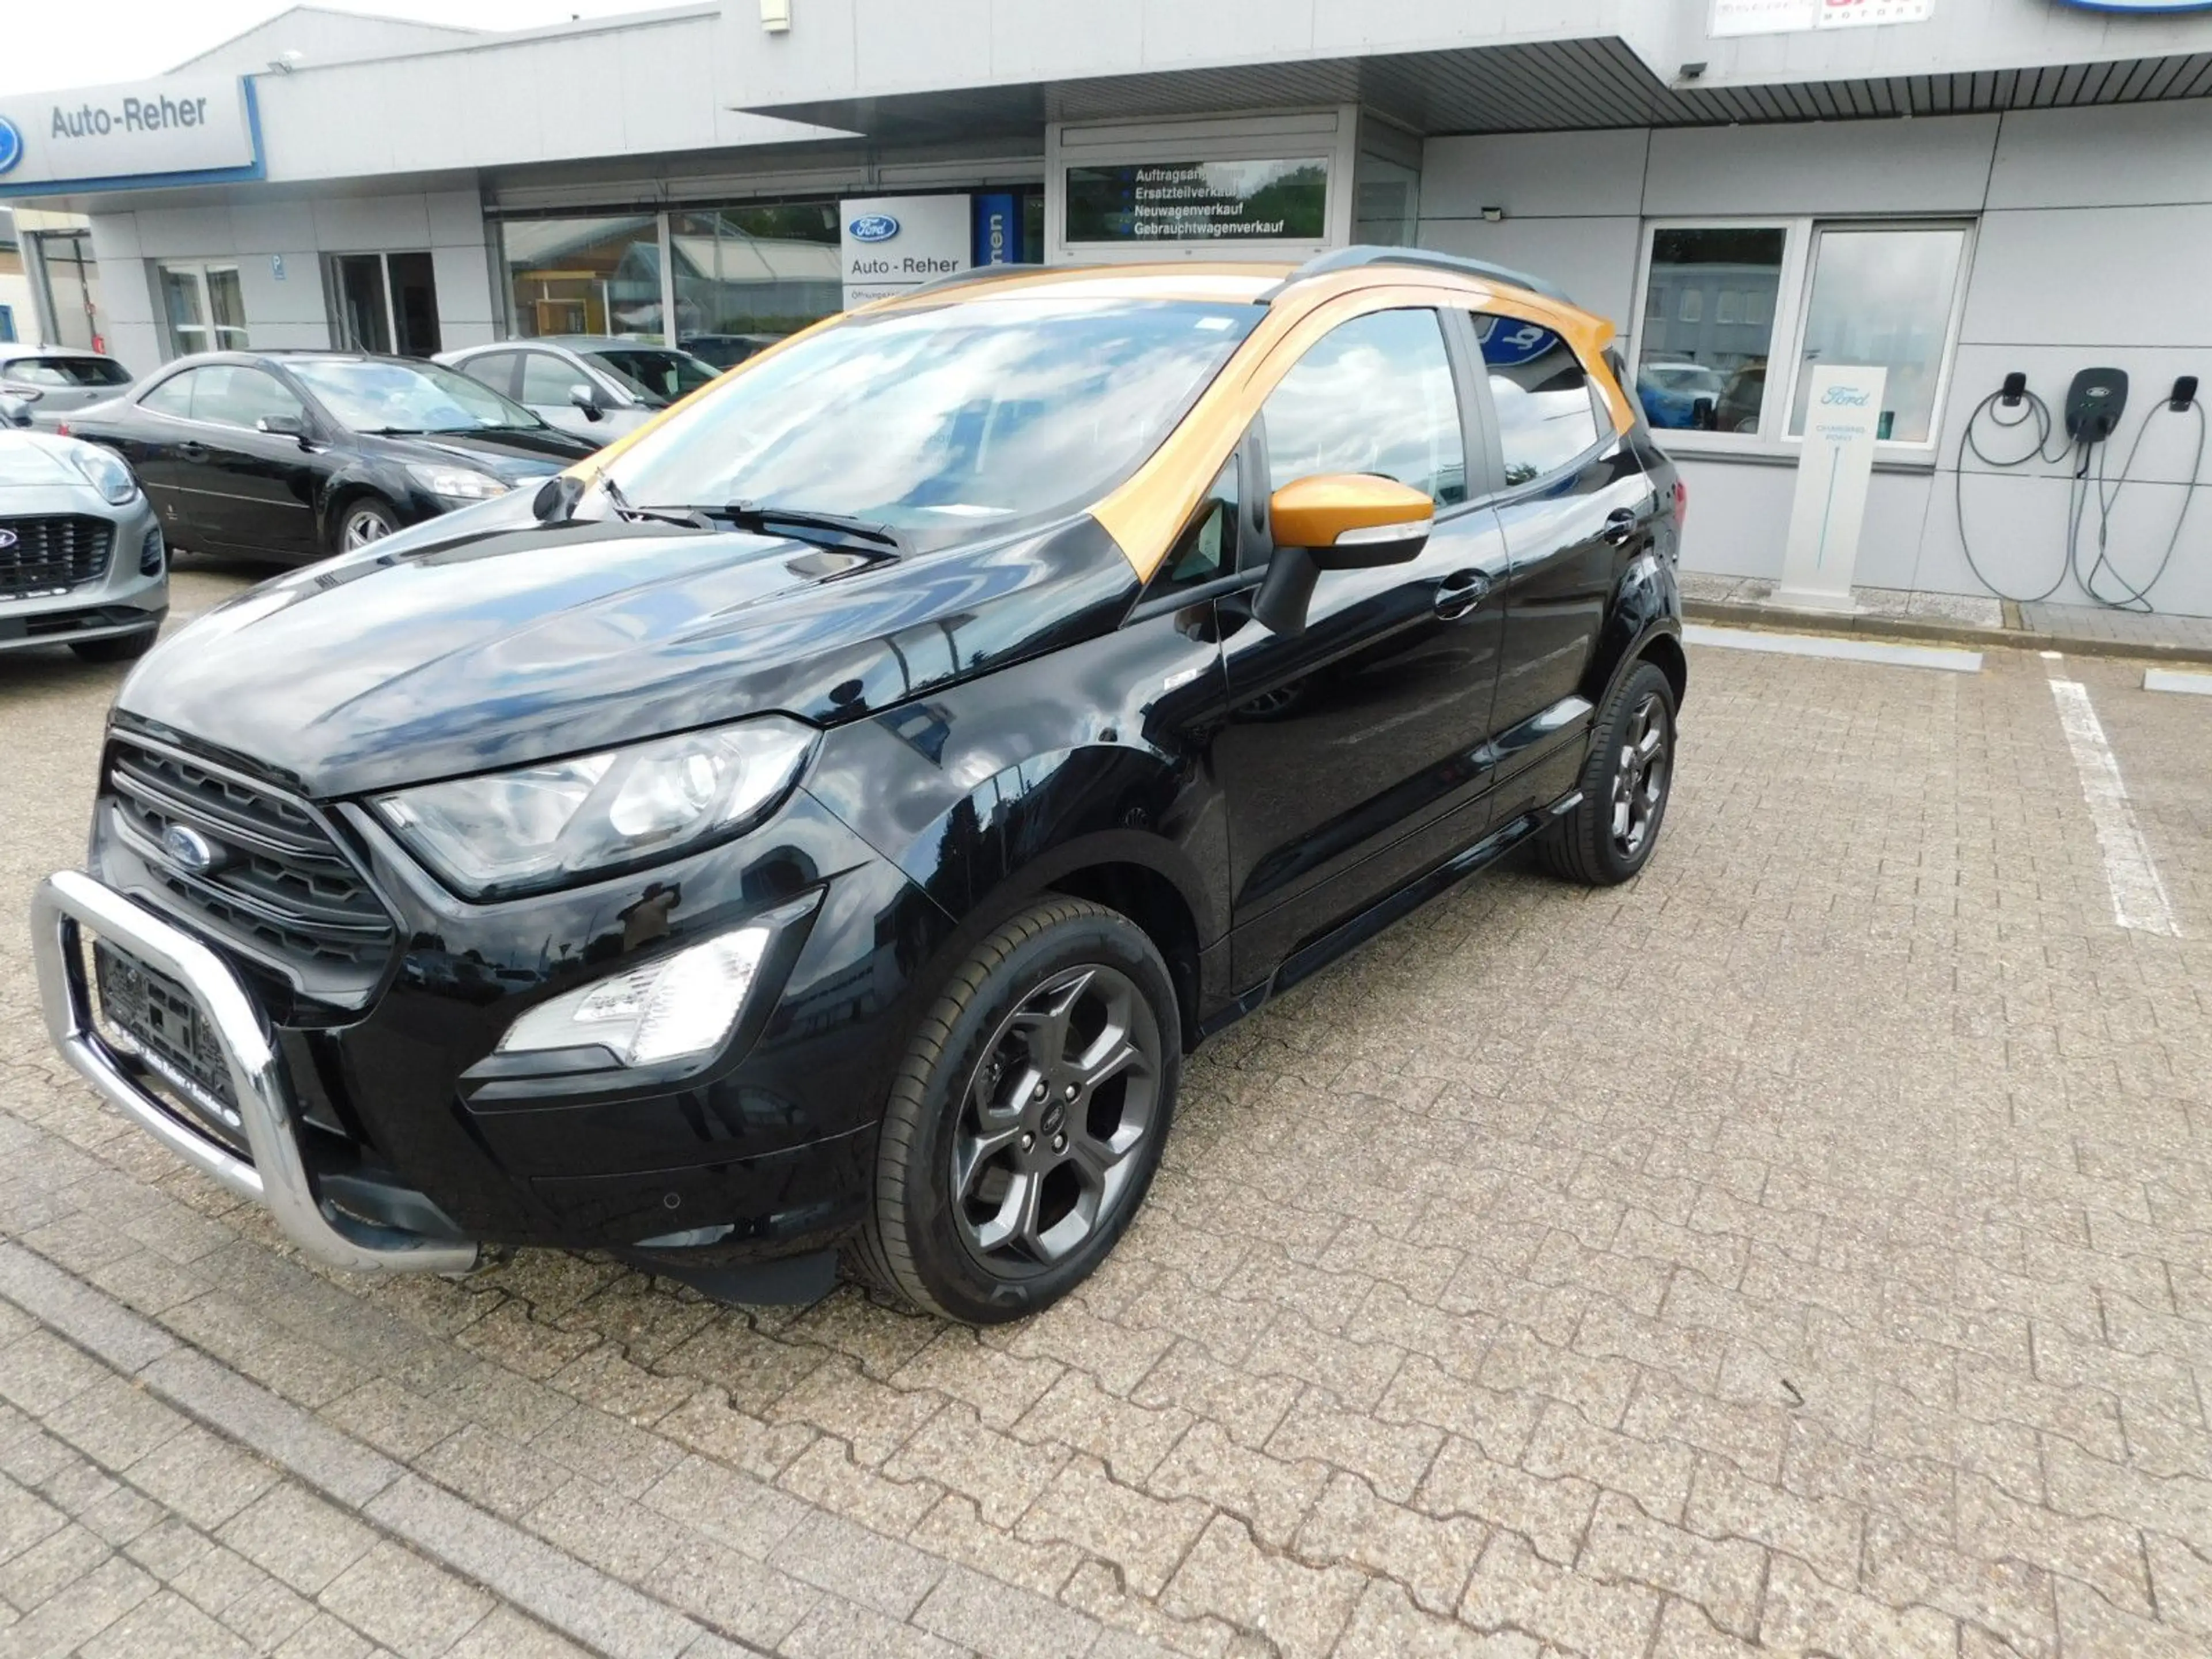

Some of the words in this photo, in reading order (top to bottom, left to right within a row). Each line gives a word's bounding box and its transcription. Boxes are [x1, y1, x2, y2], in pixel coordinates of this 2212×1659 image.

[52, 94, 207, 138] Auto-Reher
[1135, 180, 1239, 199] Ersatzteilverkauf
[1135, 202, 1244, 219] Neuwagenverkauf
[856, 217, 888, 236] Ford
[1134, 219, 1285, 236] Gebrauchtwagenverkauf
[851, 259, 889, 275] Auto
[903, 257, 959, 274] Reher
[1820, 385, 1870, 406] Ford
